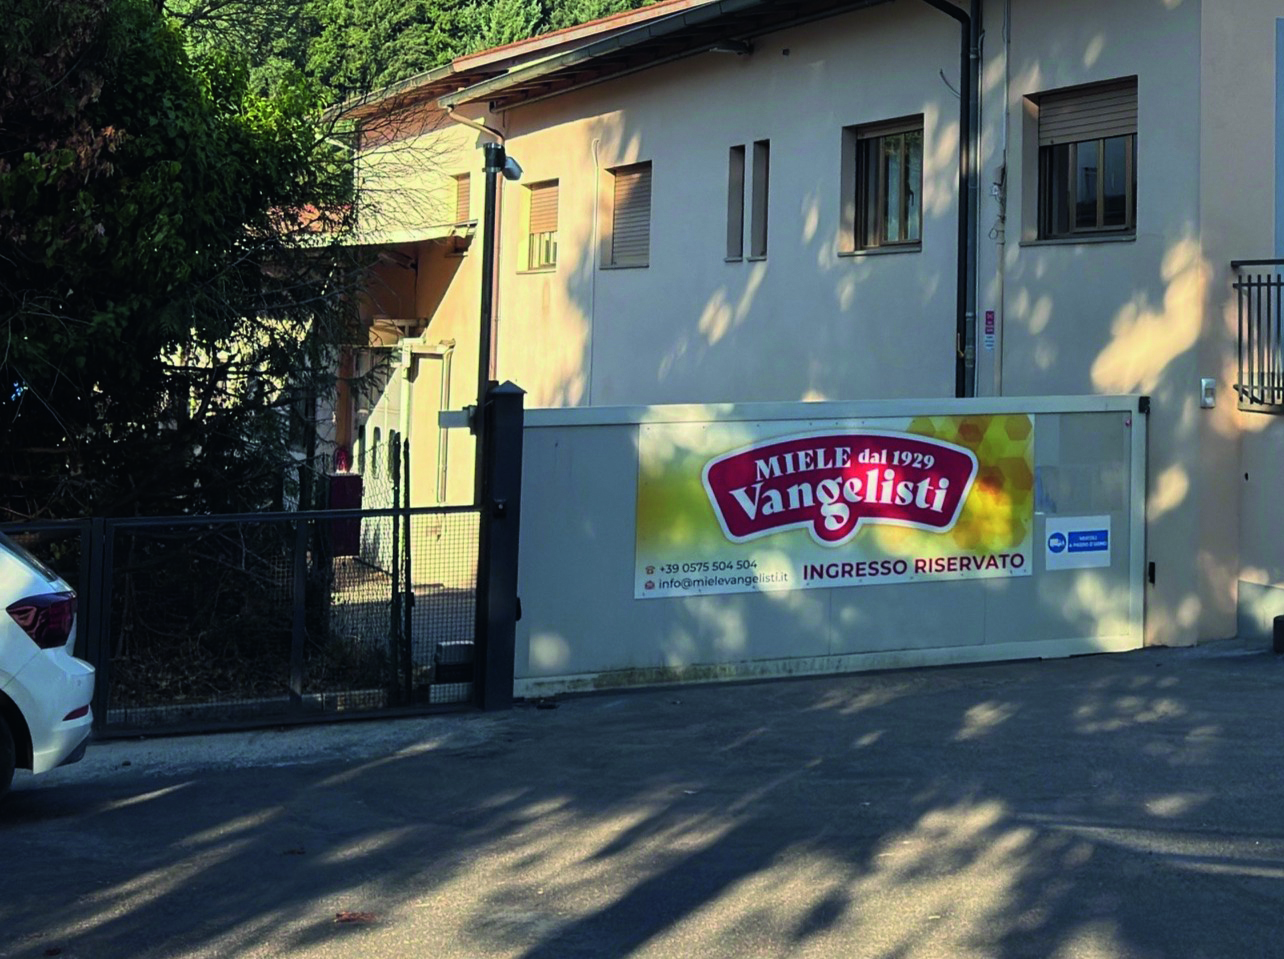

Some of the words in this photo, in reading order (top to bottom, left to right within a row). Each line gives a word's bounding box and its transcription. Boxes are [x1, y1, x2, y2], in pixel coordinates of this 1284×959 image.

[755, 447, 851, 481] MIELE
[858, 448, 887, 465] dal
[893, 450, 935, 469] 1929
[729, 469, 949, 531] Vangelisti
[659, 563, 680, 574] +39
[682, 562, 710, 573] 0575
[712, 561, 733, 572] 504
[736, 560, 758, 570] 504
[803, 559, 907, 580] INGRESSO
[914, 553, 1025, 574] RISERVATO
[658, 572, 789, 590] info@mielevangelisti.it
